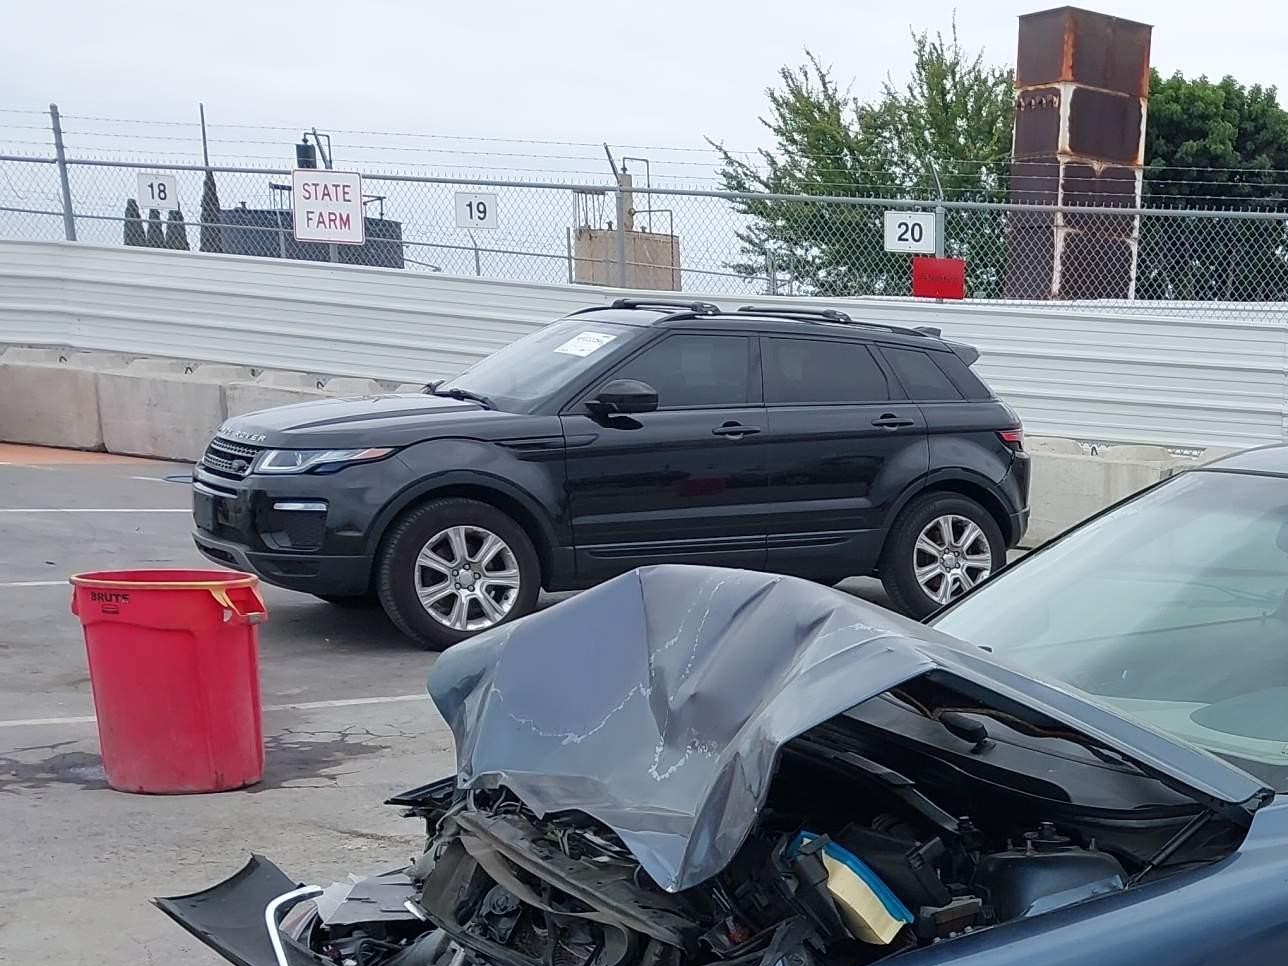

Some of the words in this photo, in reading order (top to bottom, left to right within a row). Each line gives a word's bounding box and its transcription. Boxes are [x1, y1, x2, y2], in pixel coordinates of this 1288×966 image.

[147, 182, 168, 201] 18
[302, 182, 353, 203] STATE
[305, 210, 351, 231] FARM
[465, 200, 487, 221] 19
[896, 221, 923, 243] 20
